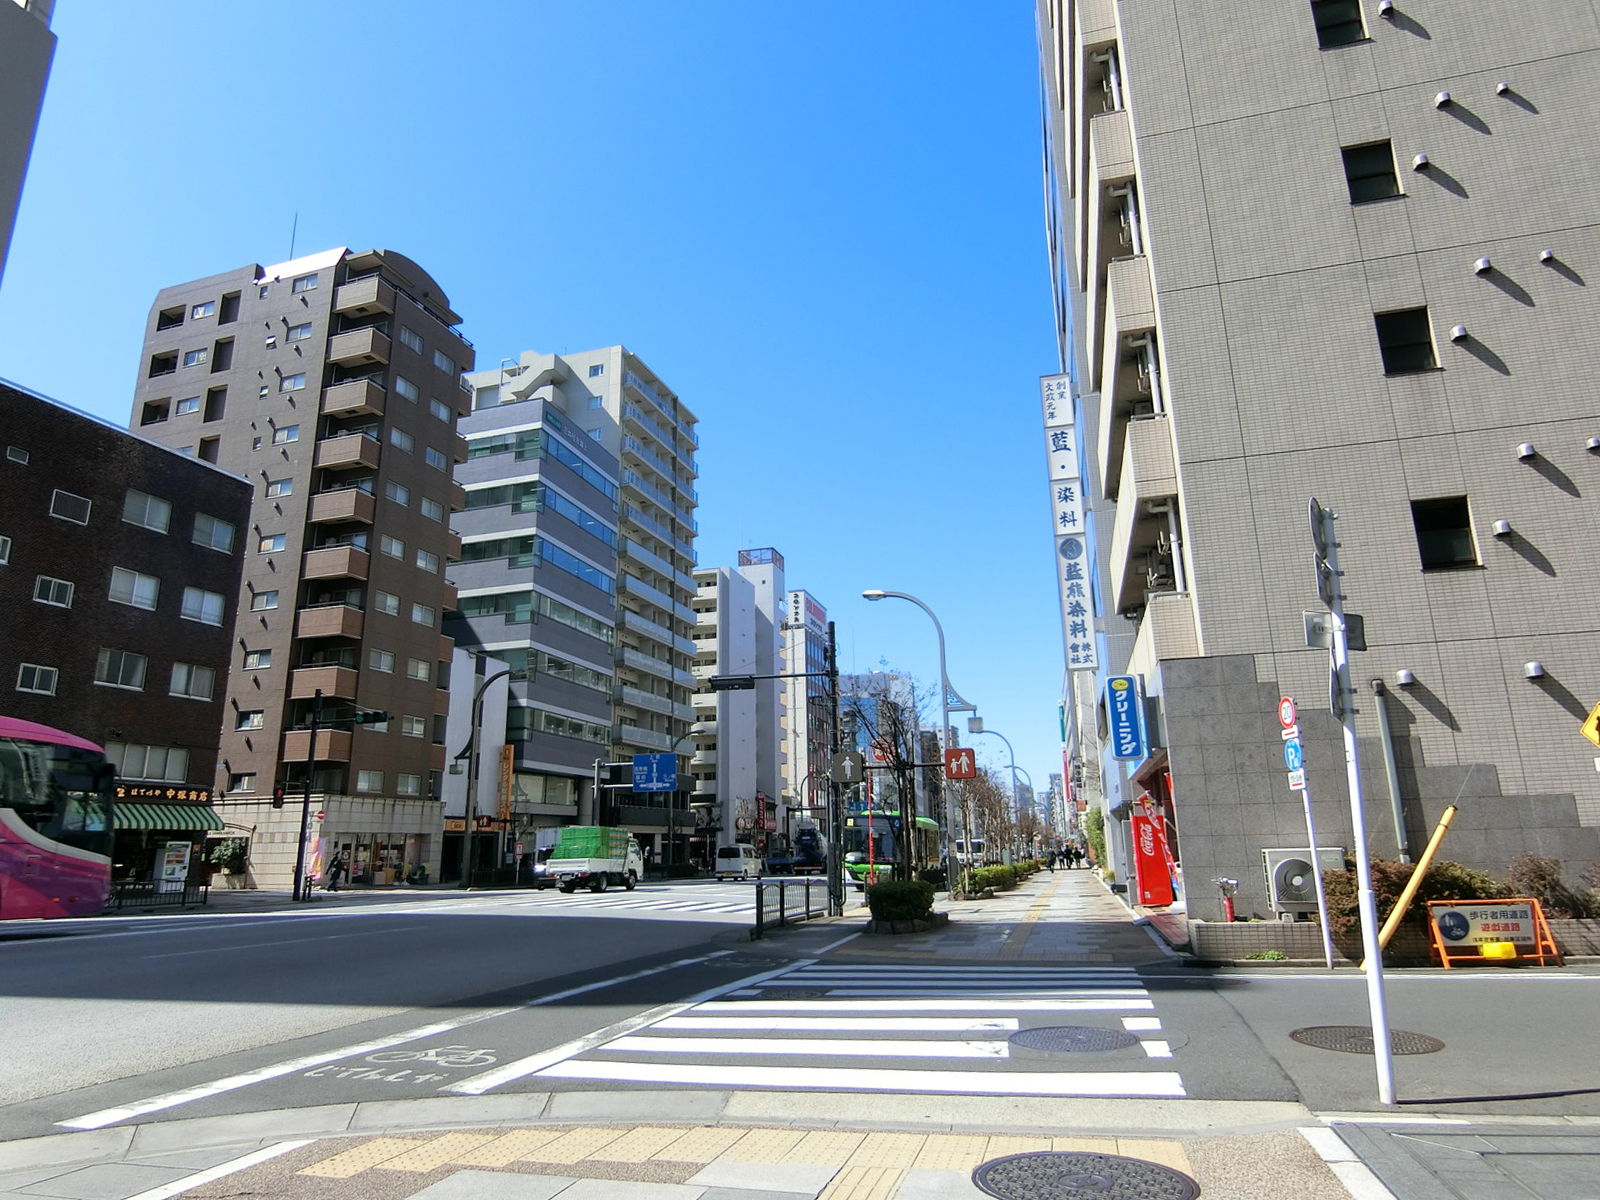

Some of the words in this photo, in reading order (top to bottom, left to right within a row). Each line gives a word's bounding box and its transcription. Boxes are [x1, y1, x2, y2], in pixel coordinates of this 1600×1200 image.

[1055, 381, 1067, 400] 創業
[1045, 382, 1057, 420] 文政元年
[1065, 562, 1088, 639] 藍熊染料
[1081, 642, 1094, 664] 株式
[1282, 705, 1292, 720] 20
[1115, 690, 1137, 755] クリーニング
[1288, 748, 1295, 767] P
[165, 788, 209, 801] 中塚商店
[1140, 822, 1155, 857] Coca-Cola
[1469, 909, 1529, 920] 歩行者用道路
[1481, 923, 1520, 931] 遊戯道路
